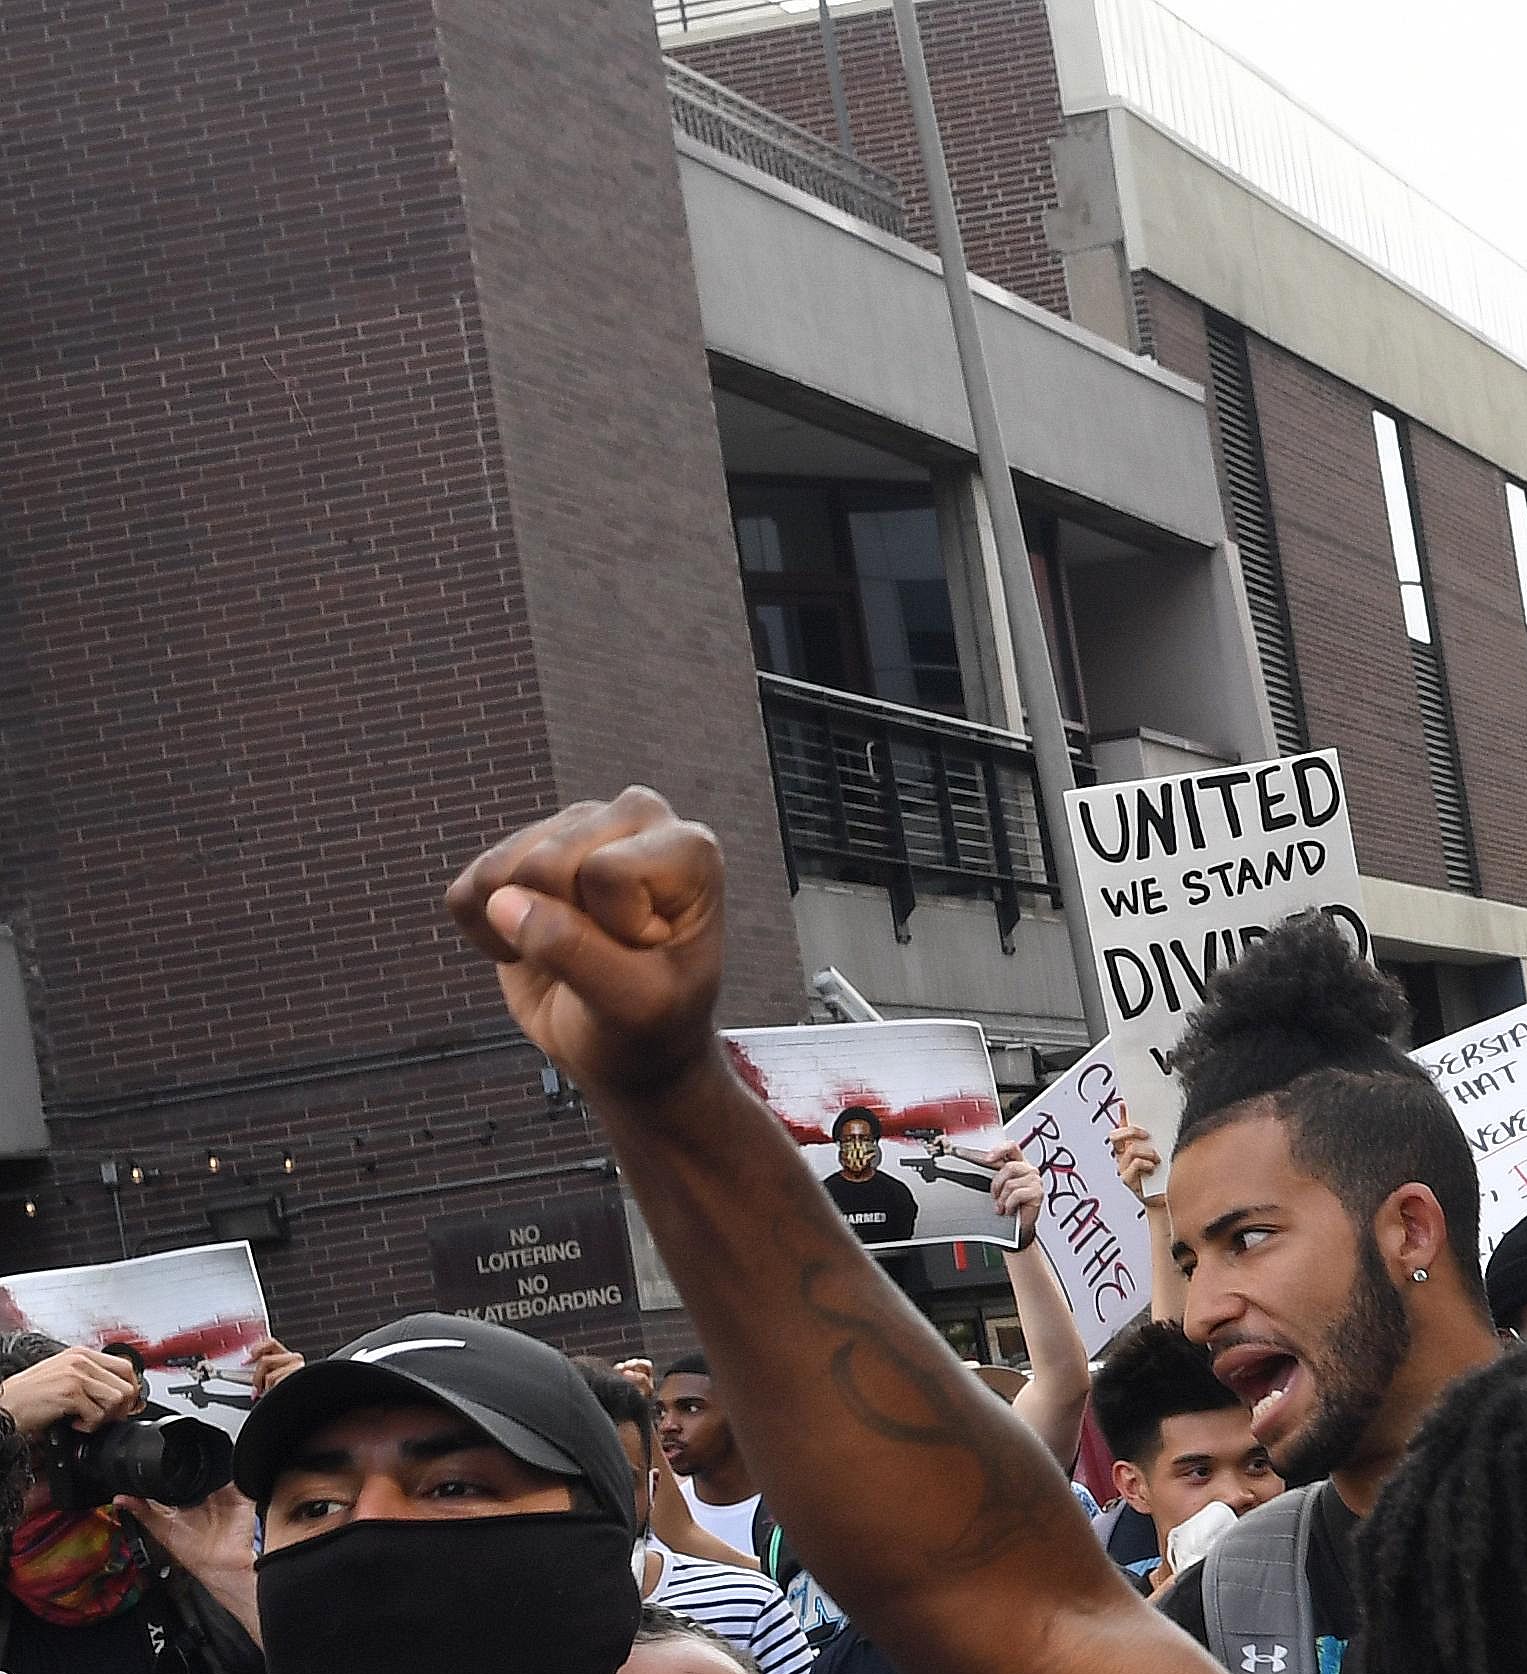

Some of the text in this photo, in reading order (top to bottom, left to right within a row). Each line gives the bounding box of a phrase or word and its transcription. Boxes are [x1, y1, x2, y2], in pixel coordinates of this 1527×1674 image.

[1077, 756, 1342, 864] UNITED
[1100, 839, 1327, 918] WE STAND
[1447, 1059, 1518, 1105] HAT
[509, 1224, 541, 1248] NO
[475, 1240, 583, 1275] LOITERING
[517, 1273, 550, 1297] NO
